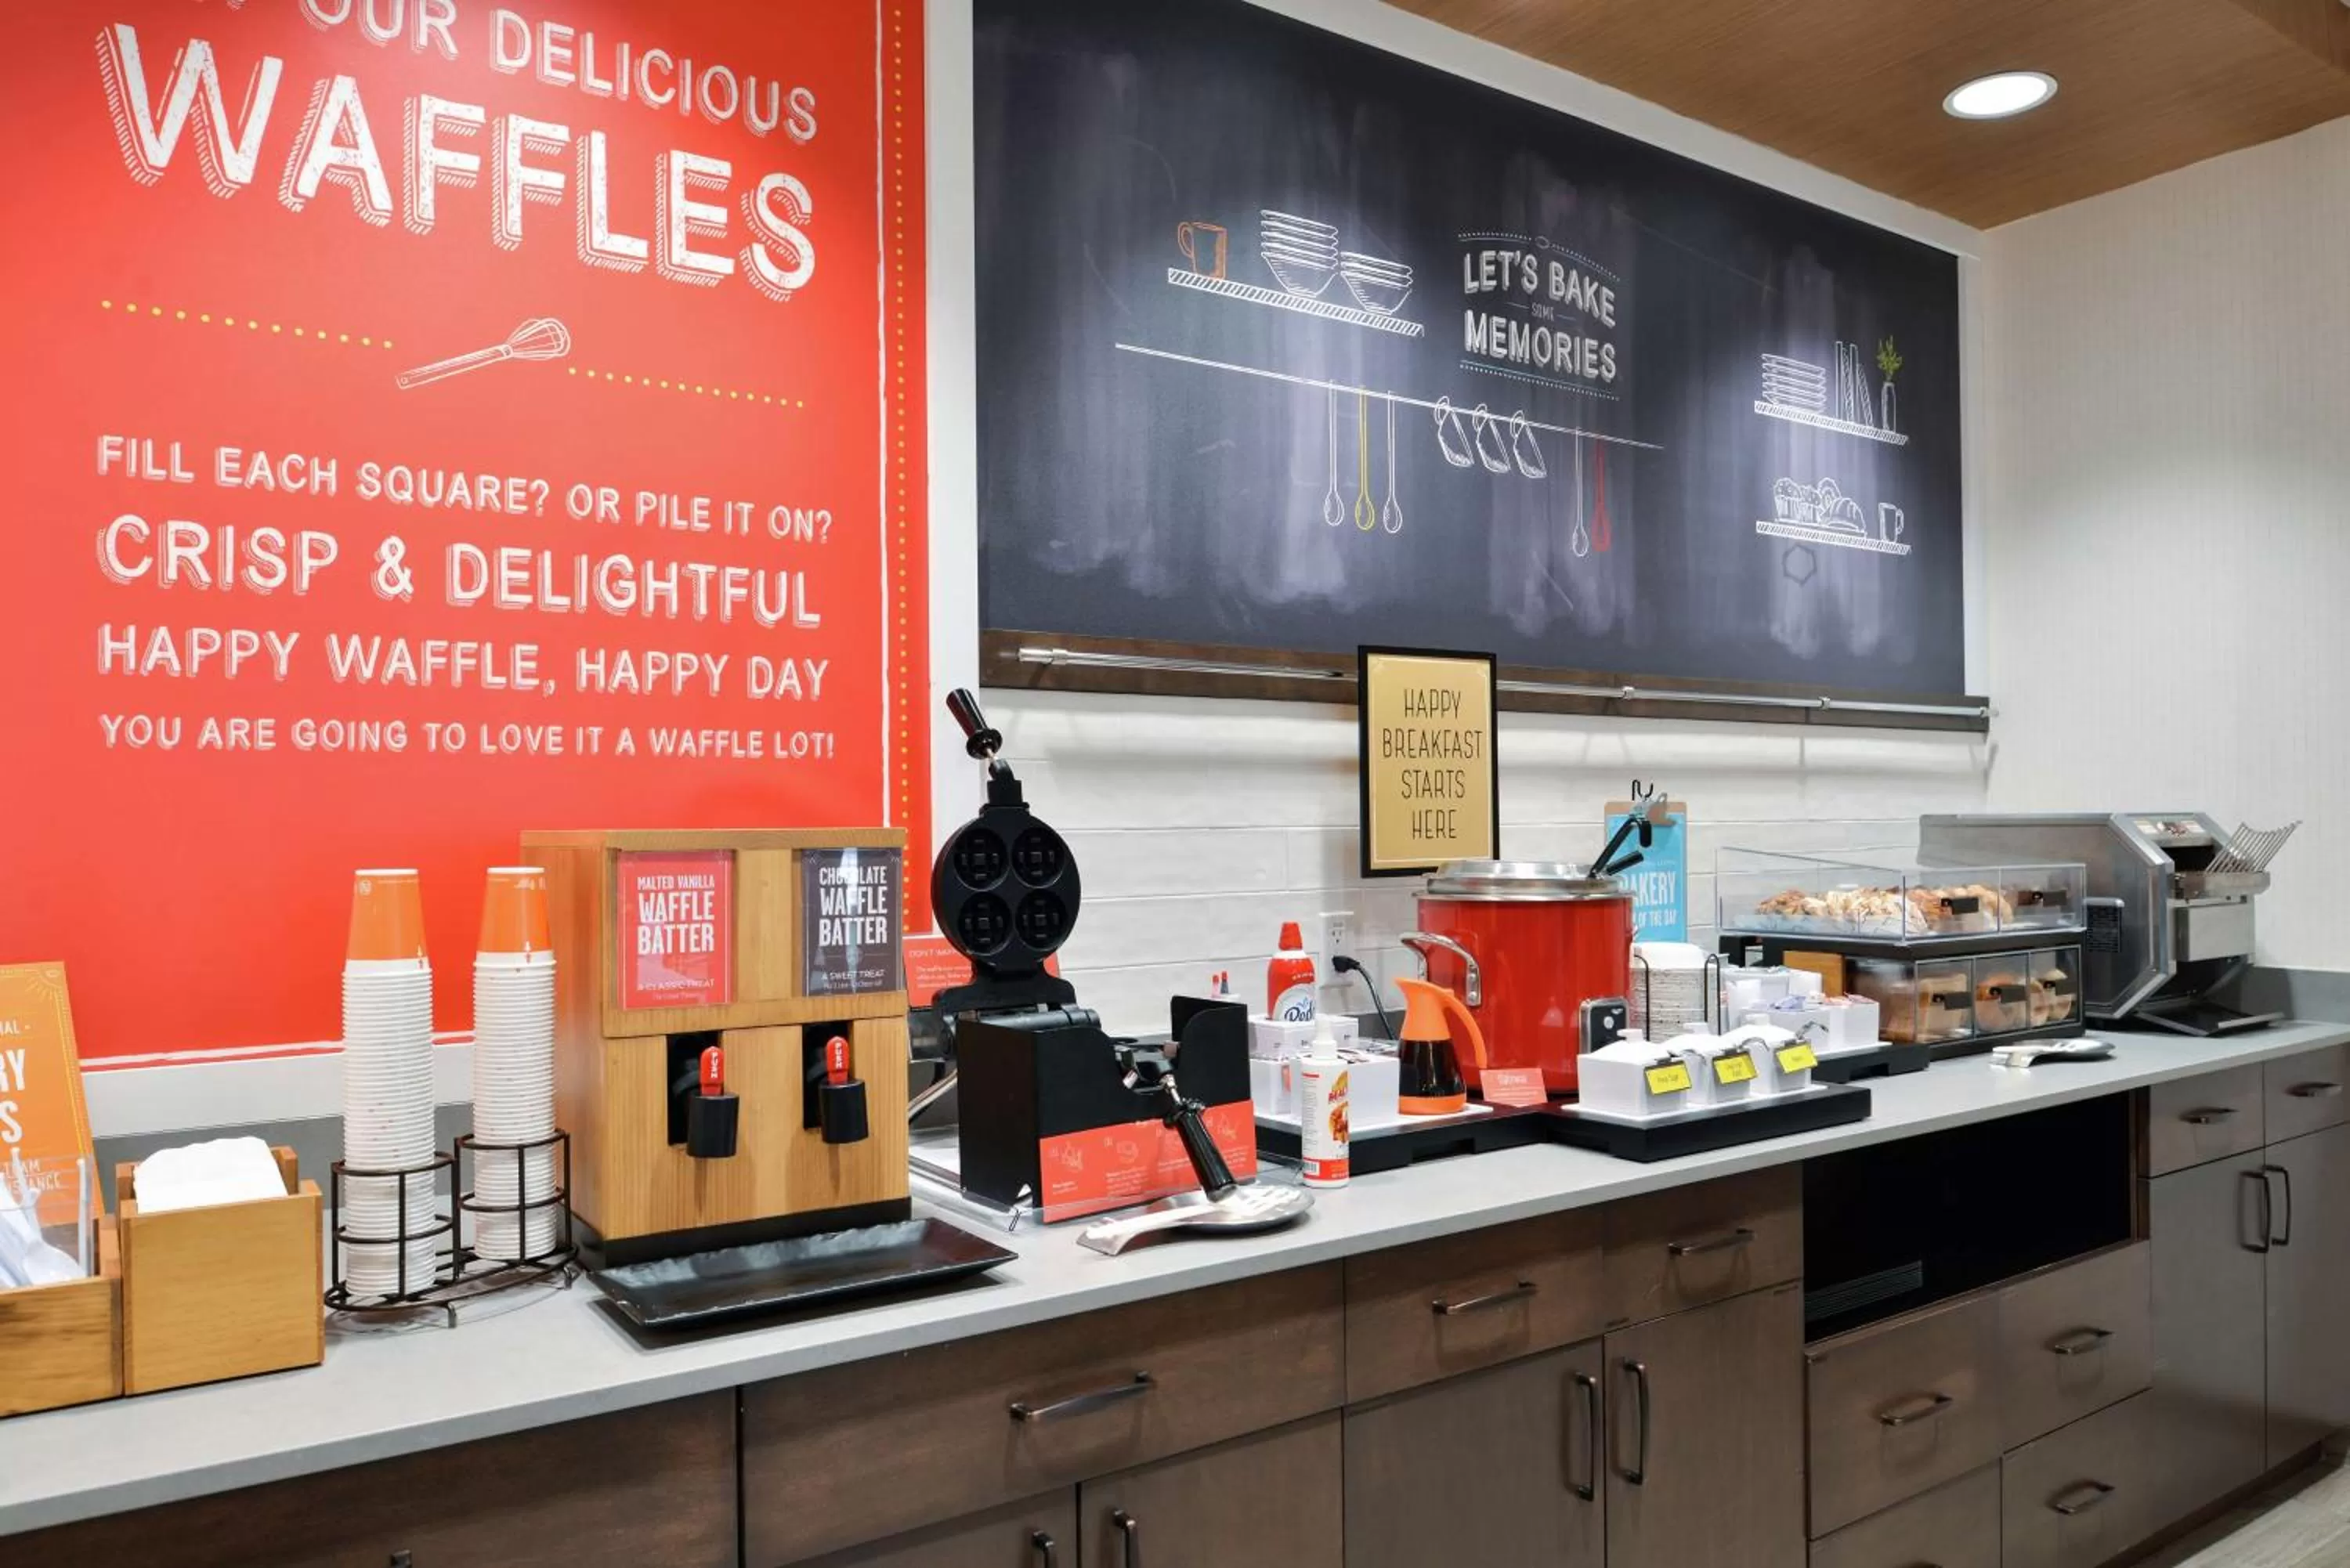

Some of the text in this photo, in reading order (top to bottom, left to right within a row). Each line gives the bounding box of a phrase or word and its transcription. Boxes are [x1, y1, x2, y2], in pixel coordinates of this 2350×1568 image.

[490, 9, 816, 145] DELICIOUS
[96, 23, 815, 302] WAFFLES
[1464, 250, 1616, 329] LET'S BAKE
[1531, 302, 1555, 321] SOME
[1464, 309, 1616, 382] MEMORIES
[98, 435, 833, 544] FILL EACH SQUARE? OR PILE IT ON?
[96, 514, 820, 629] CRISP & DELIGHTFUL
[98, 623, 829, 701] HAPPY WAFFLE, HAPPY DAY
[1403, 688, 1462, 718] HAPPY
[99, 714, 835, 759] YOU ARE GOING TO LOVE IT A WAFFLE LOT!
[1382, 728, 1483, 759] BREAKFAST
[1401, 769, 1466, 799] STARTS
[1412, 809, 1457, 840] HERE
[637, 875, 715, 891] MALTED VANILLA
[638, 891, 715, 923] WAFFLE
[819, 886, 888, 916] WAFFLE
[637, 923, 715, 956] BATTER
[819, 916, 888, 947] BATTER
